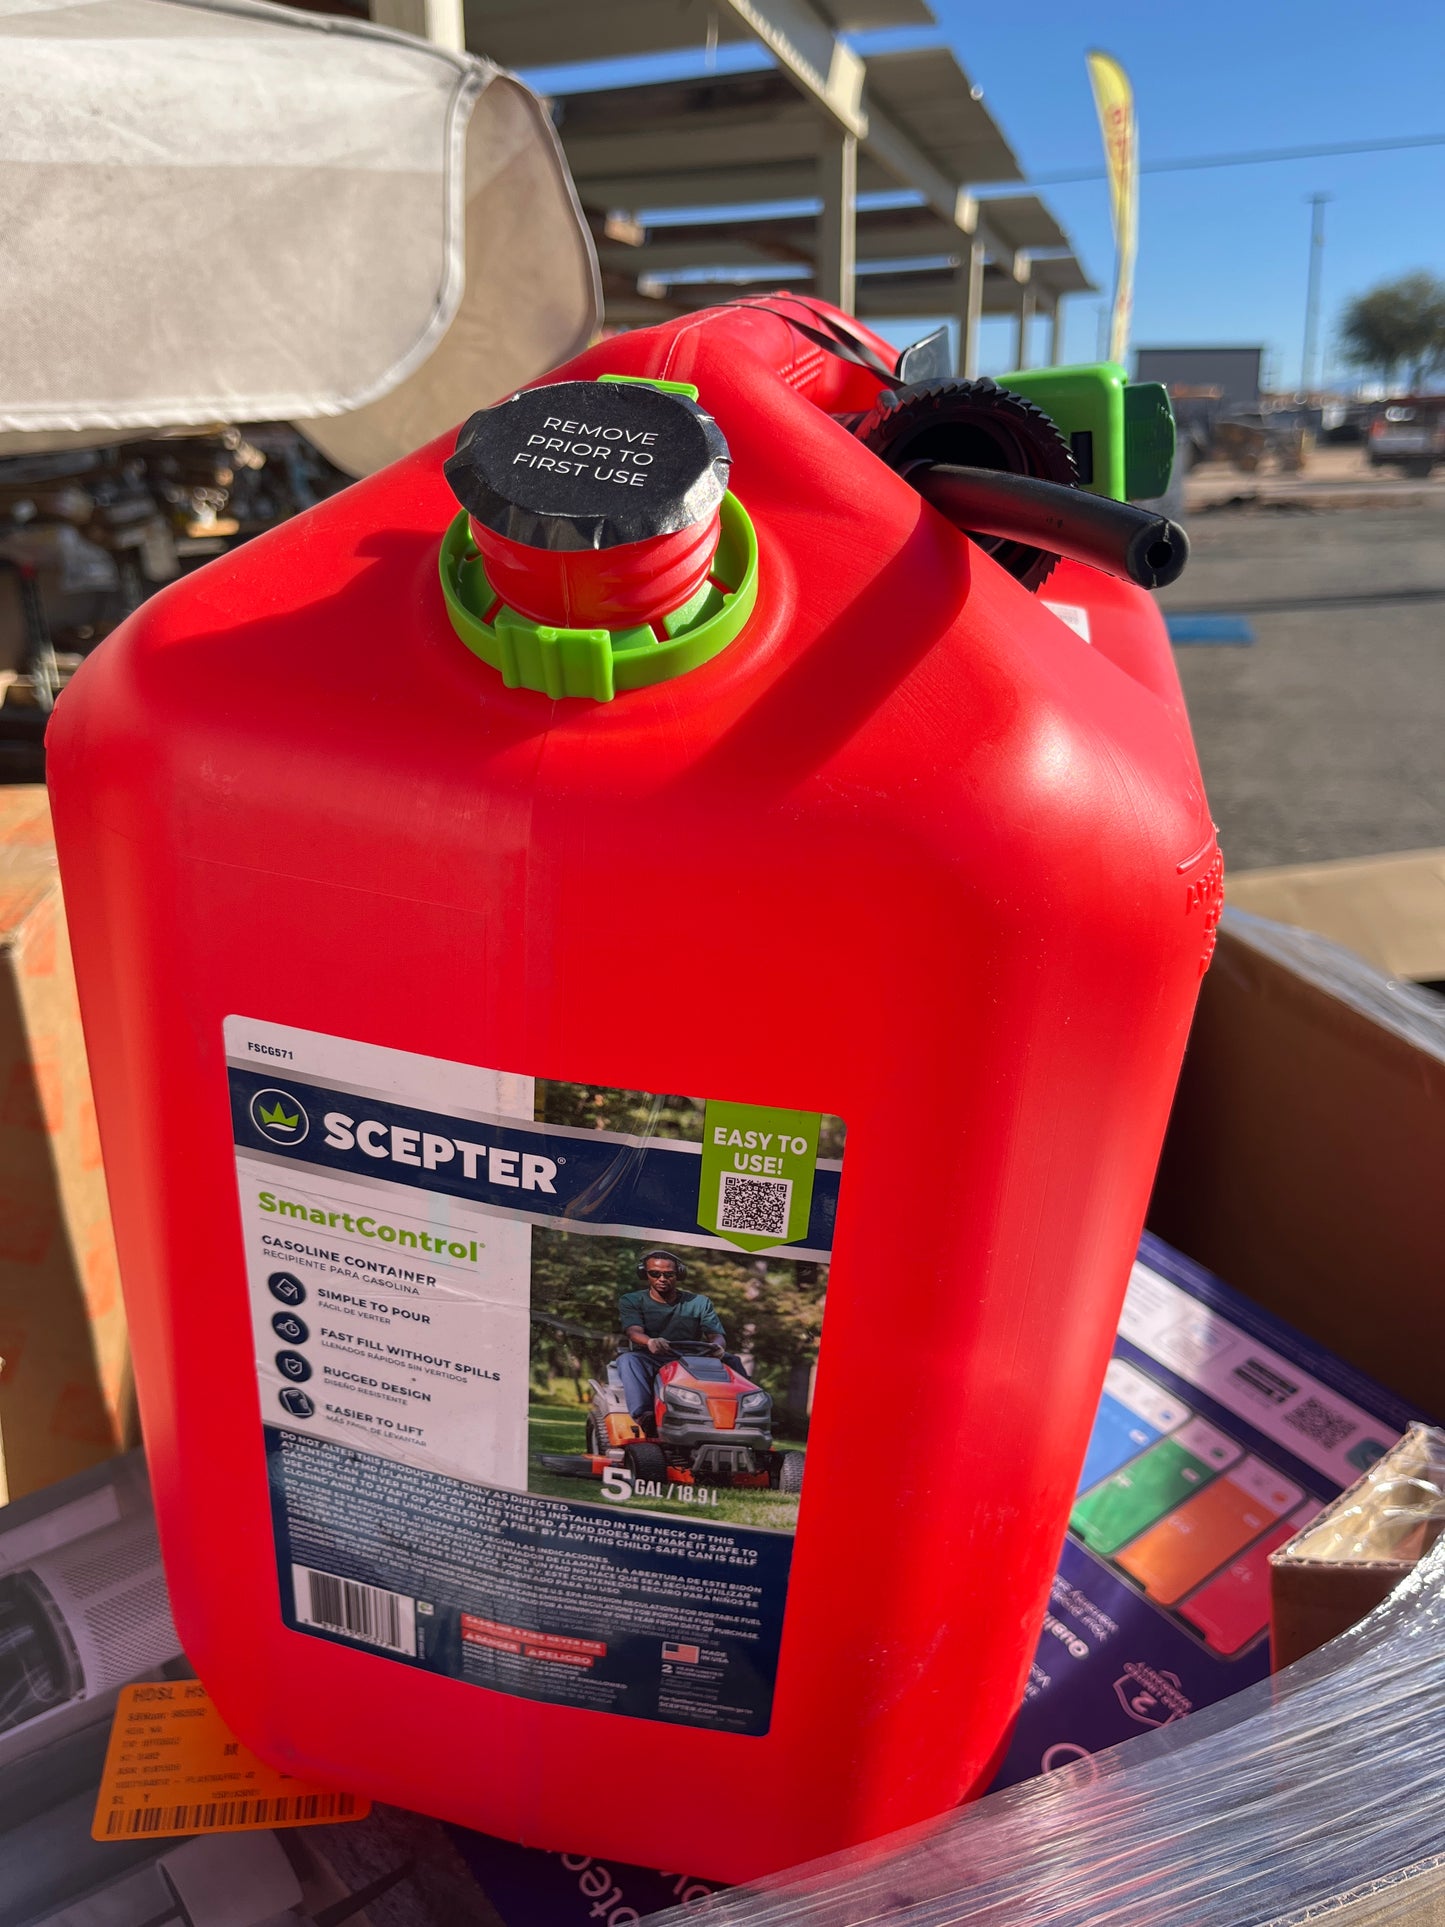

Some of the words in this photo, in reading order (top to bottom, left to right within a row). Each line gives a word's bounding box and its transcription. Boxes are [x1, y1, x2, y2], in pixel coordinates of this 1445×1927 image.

[543, 417, 659, 446] REMOVE
[527, 434, 611, 460] PRIOR
[619, 449, 654, 466] TO
[513, 453, 589, 477] FIRST
[594, 465, 648, 487] USE
[247, 1042, 294, 1060] FSCG571
[713, 1126, 772, 1151] EASY
[777, 1134, 808, 1155] TO
[733, 1152, 784, 1175] USE!
[262, 1235, 340, 1262] GASOLINE
[344, 1256, 437, 1287] CONTAINER
[263, 1248, 326, 1271] RECIPIENTE
[329, 1265, 360, 1280] PARA
[362, 1274, 420, 1295] GASOLINA
[318, 1288, 367, 1308] SIMPLE
[370, 1301, 388, 1313] TO
[392, 1307, 431, 1324] POUR
[344, 1307, 356, 1315] DE
[357, 1311, 391, 1325] VERTER
[320, 1327, 354, 1343] FAST
[357, 1336, 384, 1352] FILL
[387, 1344, 452, 1369] WITHOUT
[455, 1363, 501, 1381] SPILLS
[321, 1340, 366, 1357] LLENADOS
[367, 1350, 406, 1368] RÁPIDOS
[408, 1361, 423, 1373] SIN
[424, 1368, 468, 1384] VERTIDOS
[323, 1366, 378, 1388] RUGGED
[381, 1381, 432, 1402] DESIGN
[324, 1377, 356, 1392] DISEÑO
[357, 1386, 408, 1406] RESISTENTE
[326, 1403, 373, 1424] EASIER
[376, 1417, 394, 1429] TO
[397, 1421, 424, 1437] LIFT
[370, 1427, 382, 1436] DE
[384, 1430, 427, 1447] LEVANTAR
[281, 1431, 297, 1441] DO
[298, 1436, 321, 1448] NOT
[322, 1443, 355, 1457] ALTER
[358, 1452, 381, 1465] THIS
[383, 1460, 436, 1481] PRODUCT.
[439, 1476, 460, 1488] USE
[462, 1483, 491, 1496] ONLY
[493, 1491, 509, 1501] AS
[510, 1495, 572, 1512] DIRECTED.
[600, 1466, 634, 1501] 5
[634, 1478, 663, 1499] GAL
[677, 1484, 708, 1505] 18.9
[282, 1449, 335, 1469] GASOLINE
[363, 1472, 400, 1488] NEVER
[402, 1483, 448, 1501] REMOVE
[449, 1497, 466, 1507] OR
[467, 1502, 502, 1516] ALTER
[504, 1511, 526, 1522] THE
[528, 1517, 557, 1528] FMD.
[569, 1523, 595, 1534] FMD
[597, 1527, 630, 1539] DOES
[631, 1533, 657, 1543] NOT
[658, 1537, 694, 1549] MAKE
[695, 1542, 707, 1550] IT
[709, 1544, 740, 1555] SAFE
[741, 1548, 758, 1557] TO
[282, 1457, 303, 1469] USE
[305, 1464, 358, 1484] GASOLINE
[360, 1479, 374, 1489] TO
[375, 1482, 409, 1499] START
[410, 1494, 427, 1504] OR
[428, 1500, 499, 1525] ACCELERATE
[500, 1519, 509, 1527] A
[510, 1521, 540, 1534] FIRE.
[541, 1528, 557, 1536] BY
[559, 1530, 586, 1541] LAW
[587, 1535, 614, 1546] THIS
[616, 1539, 685, 1556] CHILD-SAFE
[687, 1550, 713, 1561] CAN
[714, 1554, 727, 1562] IS
[728, 1556, 758, 1566] SELF
[283, 1466, 328, 1484] CLOSING
[330, 1480, 354, 1491] AND
[355, 1487, 385, 1500] MUST
[386, 1495, 400, 1505] BE
[402, 1500, 461, 1522] UNLOCKED
[462, 1518, 478, 1527] TO
[479, 1522, 505, 1534] USE.
[354, 1461, 378, 1473] FMD
[380, 1468, 420, 1485] (FLAME
[422, 1480, 486, 1504] MITIGATION
[488, 1498, 533, 1515] DEVICE)
[535, 1509, 546, 1517] IS
[548, 1511, 611, 1527] INSTALLED
[613, 1521, 626, 1530] IN
[628, 1523, 652, 1533] THE
[653, 1527, 687, 1539] NECK
[688, 1532, 705, 1541] OF
[708, 1535, 735, 1546] THIS
[516, 1543, 536, 1553] LAS
[544, 1570, 570, 1580] ESTE
[570, 1574, 640, 1590] CONTENEDOR
[640, 1585, 682, 1597] SEGURO
[682, 1591, 711, 1601] PARA
[746, 1600, 760, 1608] SE
[546, 1555, 560, 1563] DE
[600, 1564, 614, 1572] EN
[616, 1566, 630, 1574] LA
[630, 1569, 685, 1583] ABERTURA
[686, 1576, 701, 1585] DE
[702, 1579, 728, 1589] ESTE
[549, 1563, 572, 1573] FMD
[572, 1567, 588, 1575] NO
[588, 1570, 617, 1580] HACE
[618, 1574, 640, 1583] QUE
[640, 1577, 661, 1586] SEA
[662, 1581, 704, 1592] SEGURO
[705, 1587, 752, 1599] UTILIZAR
[555, 1579, 583, 1589] PARA
[584, 1583, 598, 1592] SU
[538, 1649, 592, 1665] PELIGRO
[661, 1663, 673, 1674] 2
[700, 1649, 727, 1658] MADE
